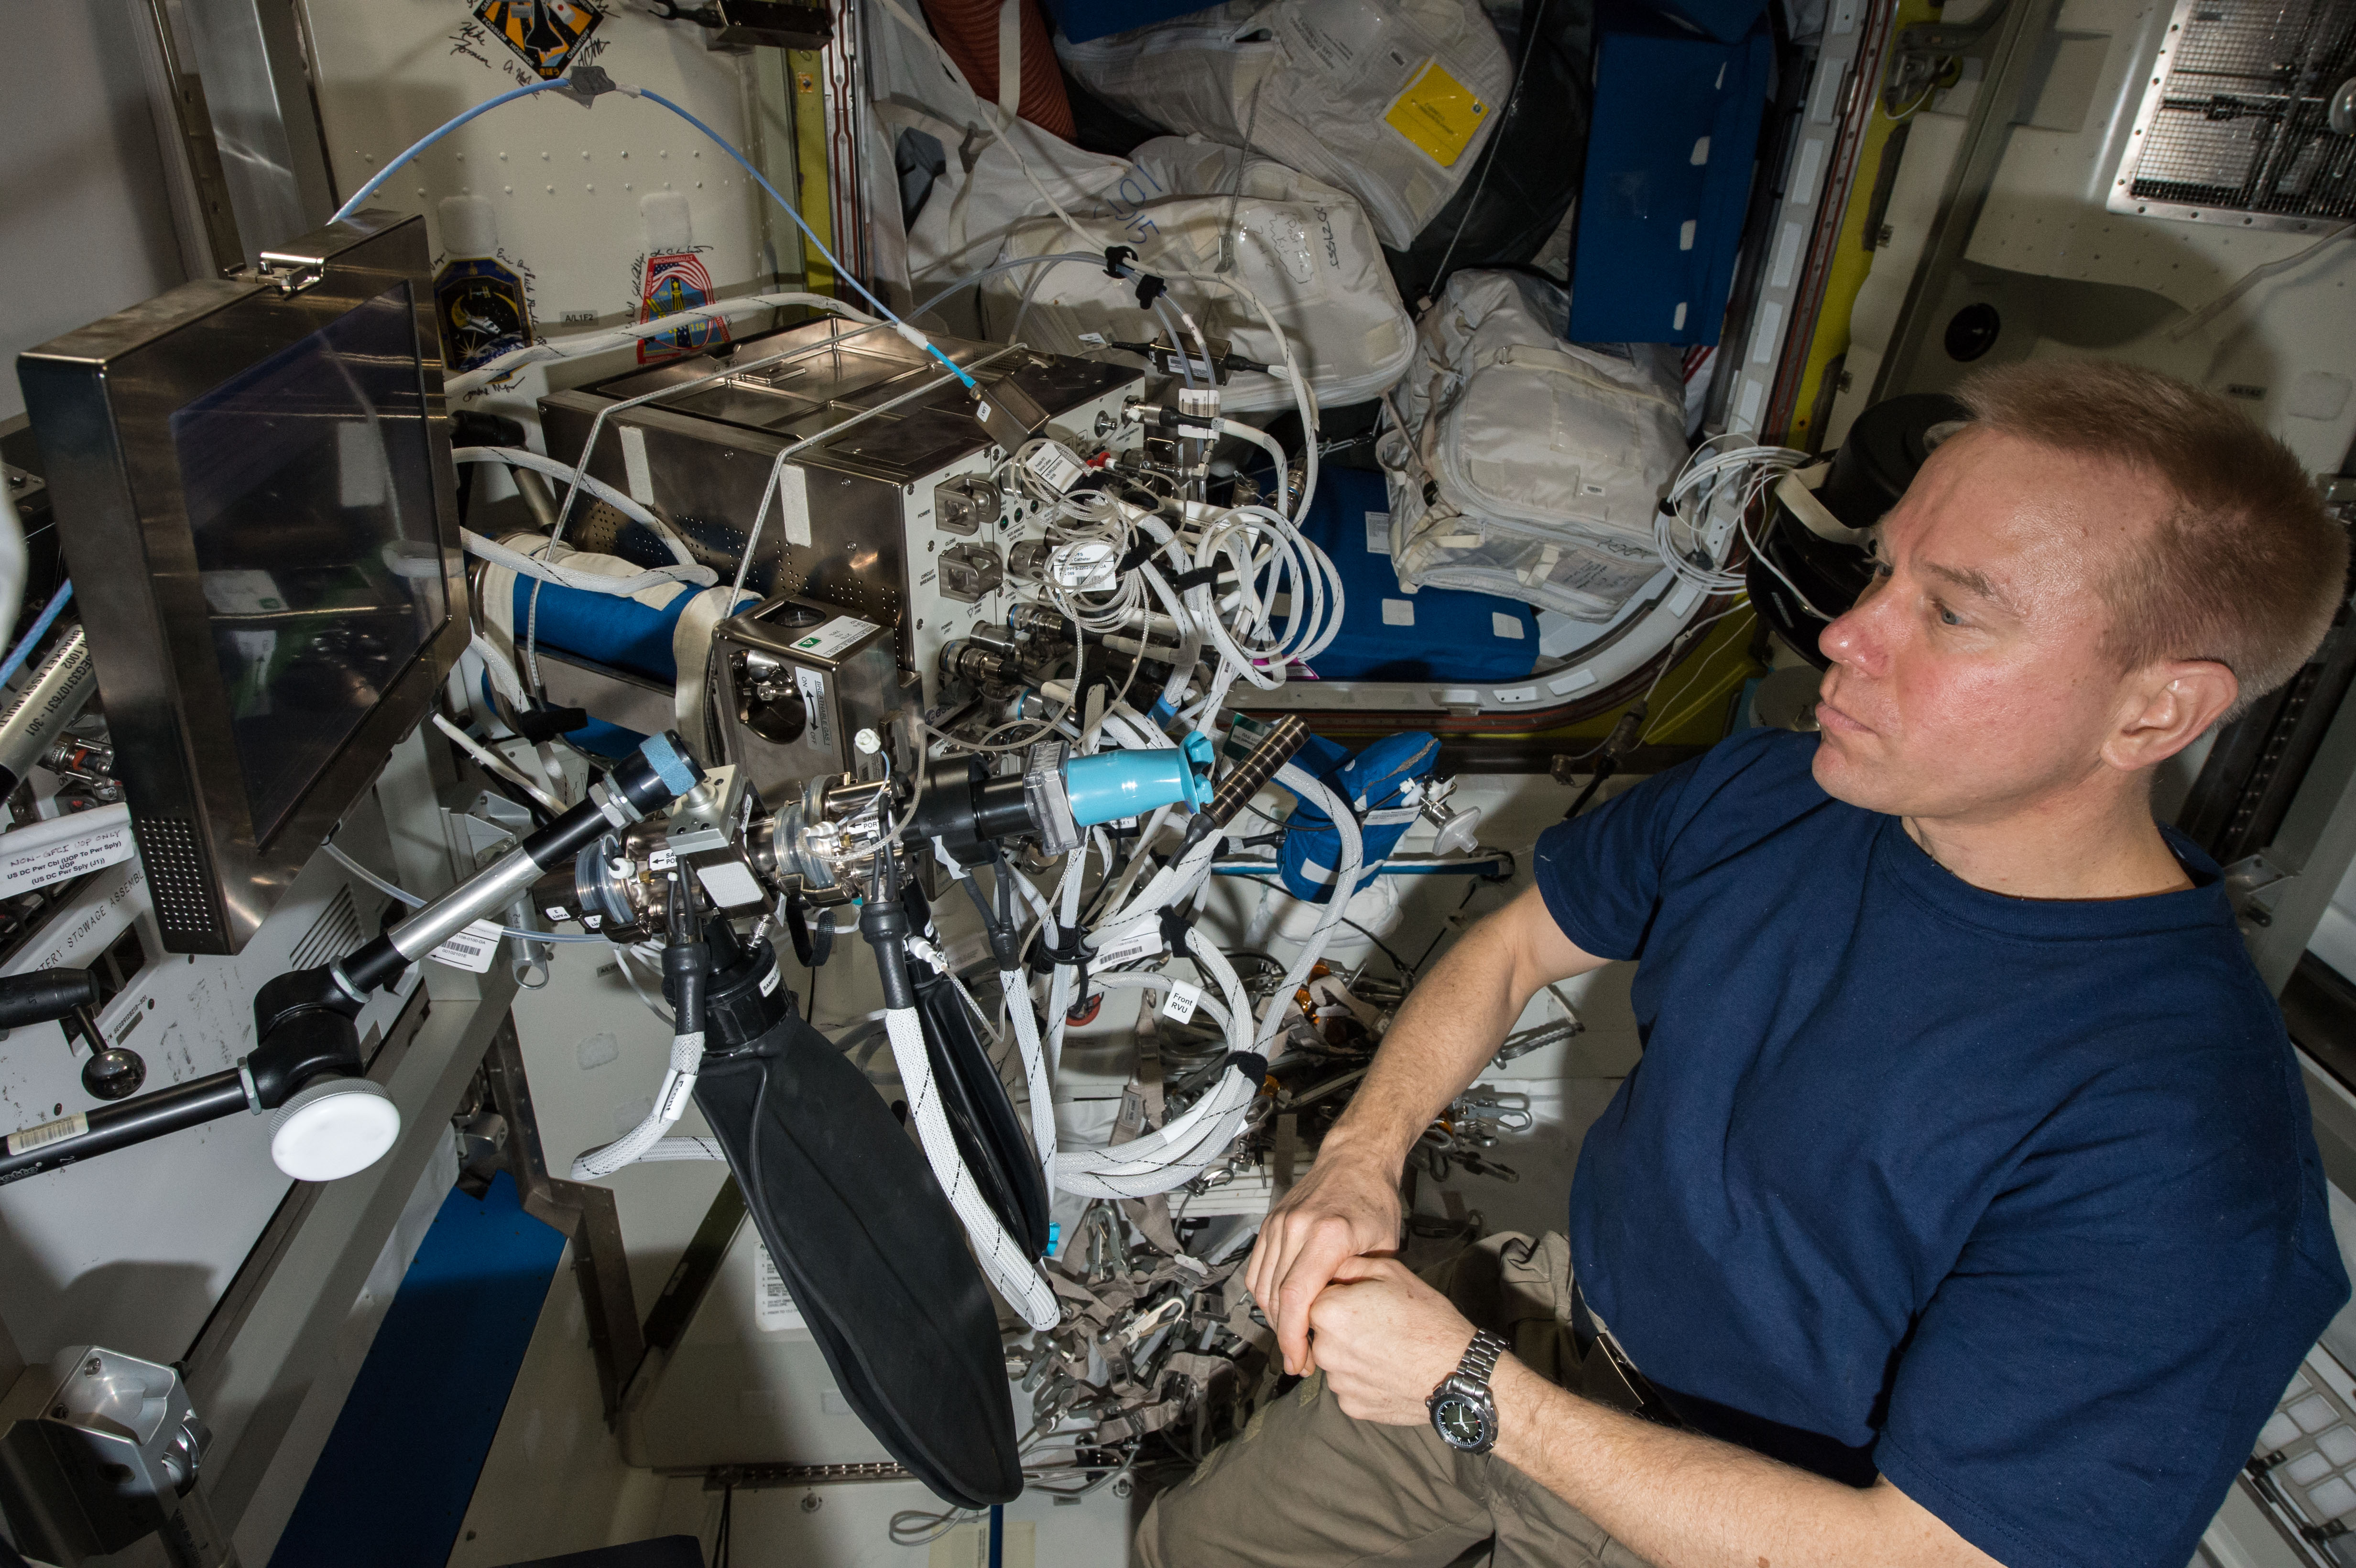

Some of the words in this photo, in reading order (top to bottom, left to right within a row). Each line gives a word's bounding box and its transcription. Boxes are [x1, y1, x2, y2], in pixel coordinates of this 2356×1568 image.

[482, 17, 507, 41] FOSSUM
[510, 43, 534, 67] HOSHIDE
[567, 29, 590, 59] CHAMITOFF
[1285, 218, 1299, 245] Post
[653, 255, 693, 263] ARCHAMBAULT
[645, 272, 653, 297] PHILLIPS
[565, 314, 594, 322] A/L1F2
[691, 323, 705, 331] 119
[918, 509, 930, 519] POWER
[945, 537, 956, 546] CLOSE
[920, 574, 936, 586] BREAKER
[921, 569, 934, 579] CIRCUIT
[941, 621, 953, 631] POWER
[844, 625, 876, 646] BREATHABLE
[44, 630, 83, 671] BRACKET
[829, 645, 843, 653] GAS
[62, 650, 83, 669] 1002
[801, 676, 808, 687] ON
[816, 681, 828, 725] BREATHABLE
[25, 718, 44, 736] 301
[11, 845, 69, 867] NON-GFCI
[75, 838, 92, 849] UOP
[96, 830, 120, 841] ONLY
[33, 864, 45, 872] Pwr
[61, 854, 78, 864] (UOP
[90, 847, 103, 855] Pwr
[104, 840, 122, 851] Sply)
[32, 876, 45, 885] (US
[73, 862, 88, 872] Sply
[90, 858, 105, 867] (J1))
[59, 861, 75, 870] UOP
[35, 946, 63, 971] TERY
[67, 905, 106, 947] STOWAGE
[109, 870, 144, 908] ASSEMBL
[763, 972, 777, 991] SAMPLE
[1171, 1002, 1188, 1013] RVU
[1173, 992, 1193, 1006] Front
[665, 1080, 684, 1111] Front
